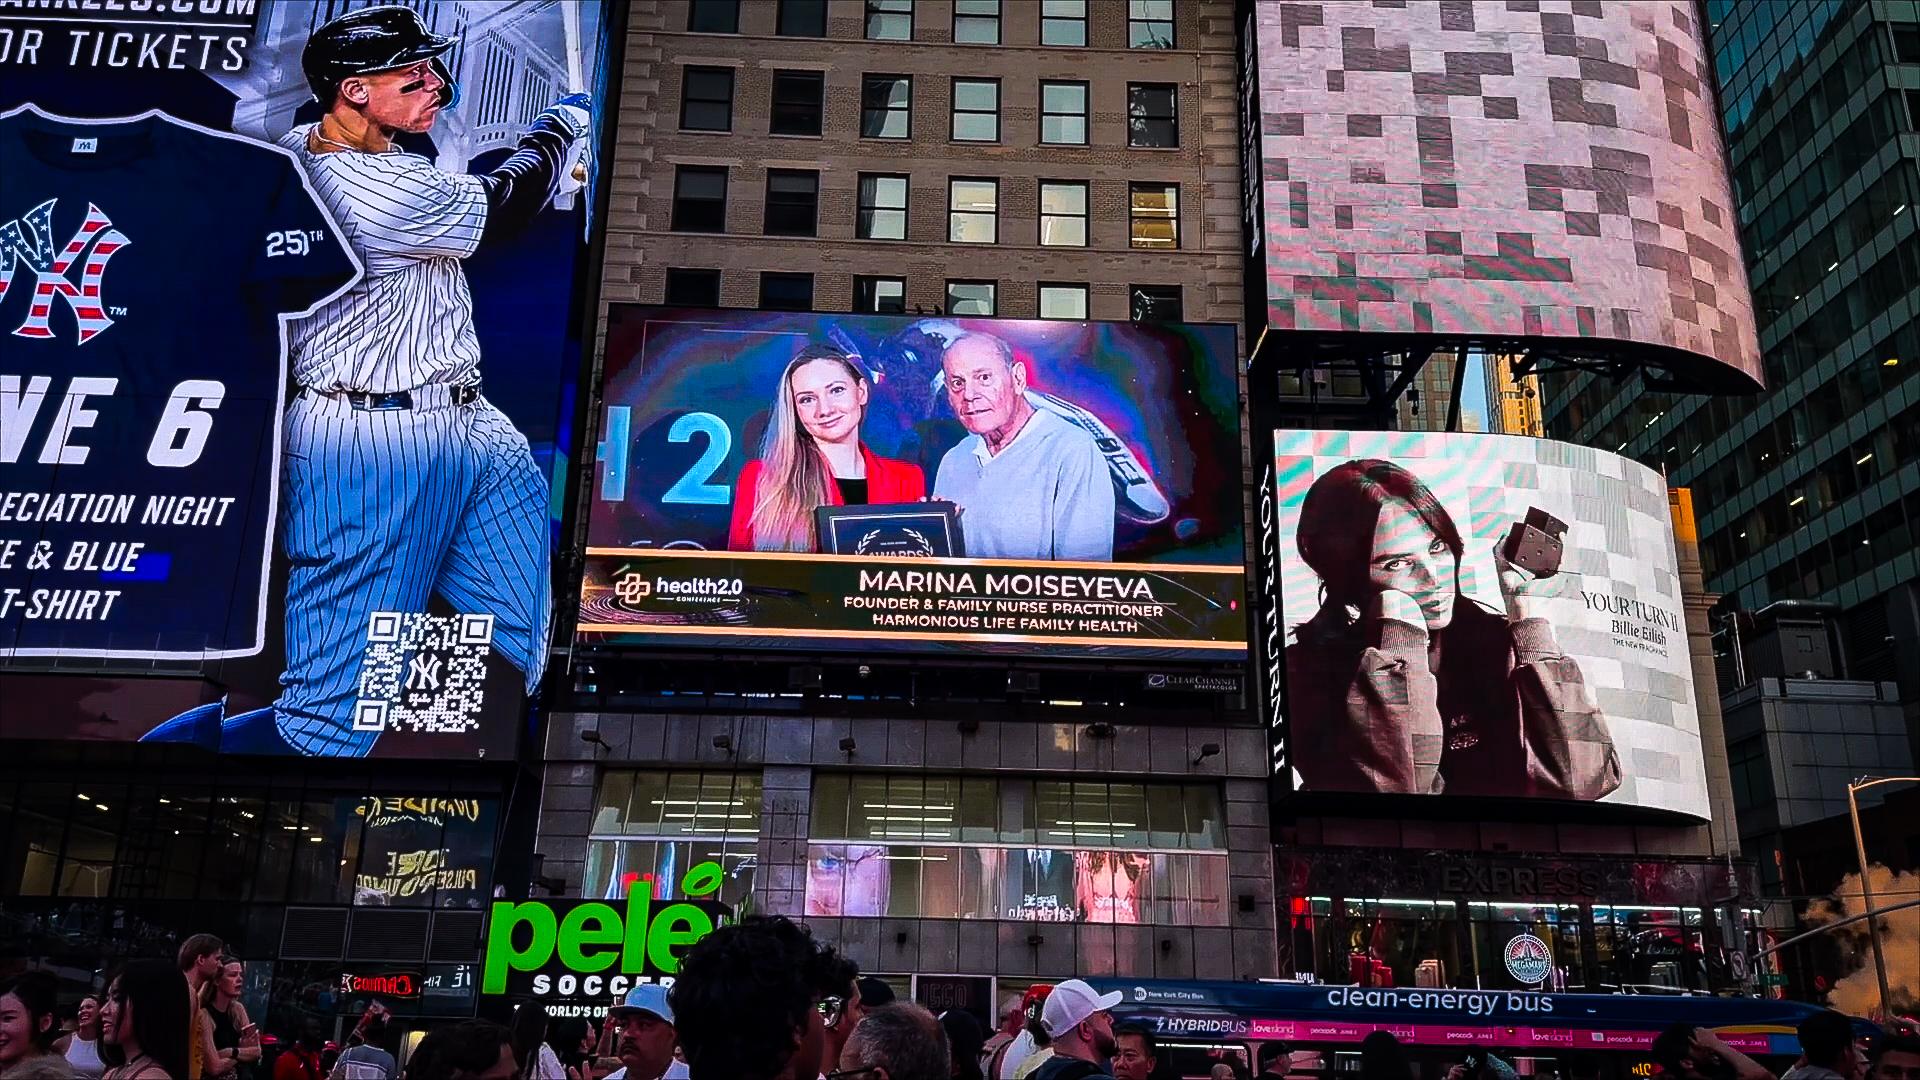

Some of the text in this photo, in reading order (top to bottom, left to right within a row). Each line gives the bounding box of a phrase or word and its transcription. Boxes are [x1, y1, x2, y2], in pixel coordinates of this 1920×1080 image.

[69, 30, 247, 71] TICKETS
[147, 380, 226, 468] 6
[662, 411, 732, 505] 2
[0, 492, 235, 526] ECIATION NIGHT
[1261, 464, 1274, 595] YOUR
[0, 540, 145, 572] E & BLUE
[656, 576, 743, 596] health2.0
[859, 570, 1154, 600] MARINA MOISEYEVA
[0, 588, 121, 621] T-SHIRT
[844, 596, 1163, 618] FOUNDER & FAMILY NURSE PRACTITIONER
[1580, 590, 1631, 617] YOUR
[1632, 599, 1670, 628] TURN
[872, 613, 1139, 633] HARMONIOUS LIFE FAMILY HEALTH
[1611, 619, 1667, 646] Billie Eilish
[1266, 594, 1283, 728] TURN
[1442, 866, 1602, 896] EXPRESS
[482, 861, 723, 994] pelé
[921, 983, 968, 1009] 1560
[1328, 988, 1553, 1015] clean-energy bus
